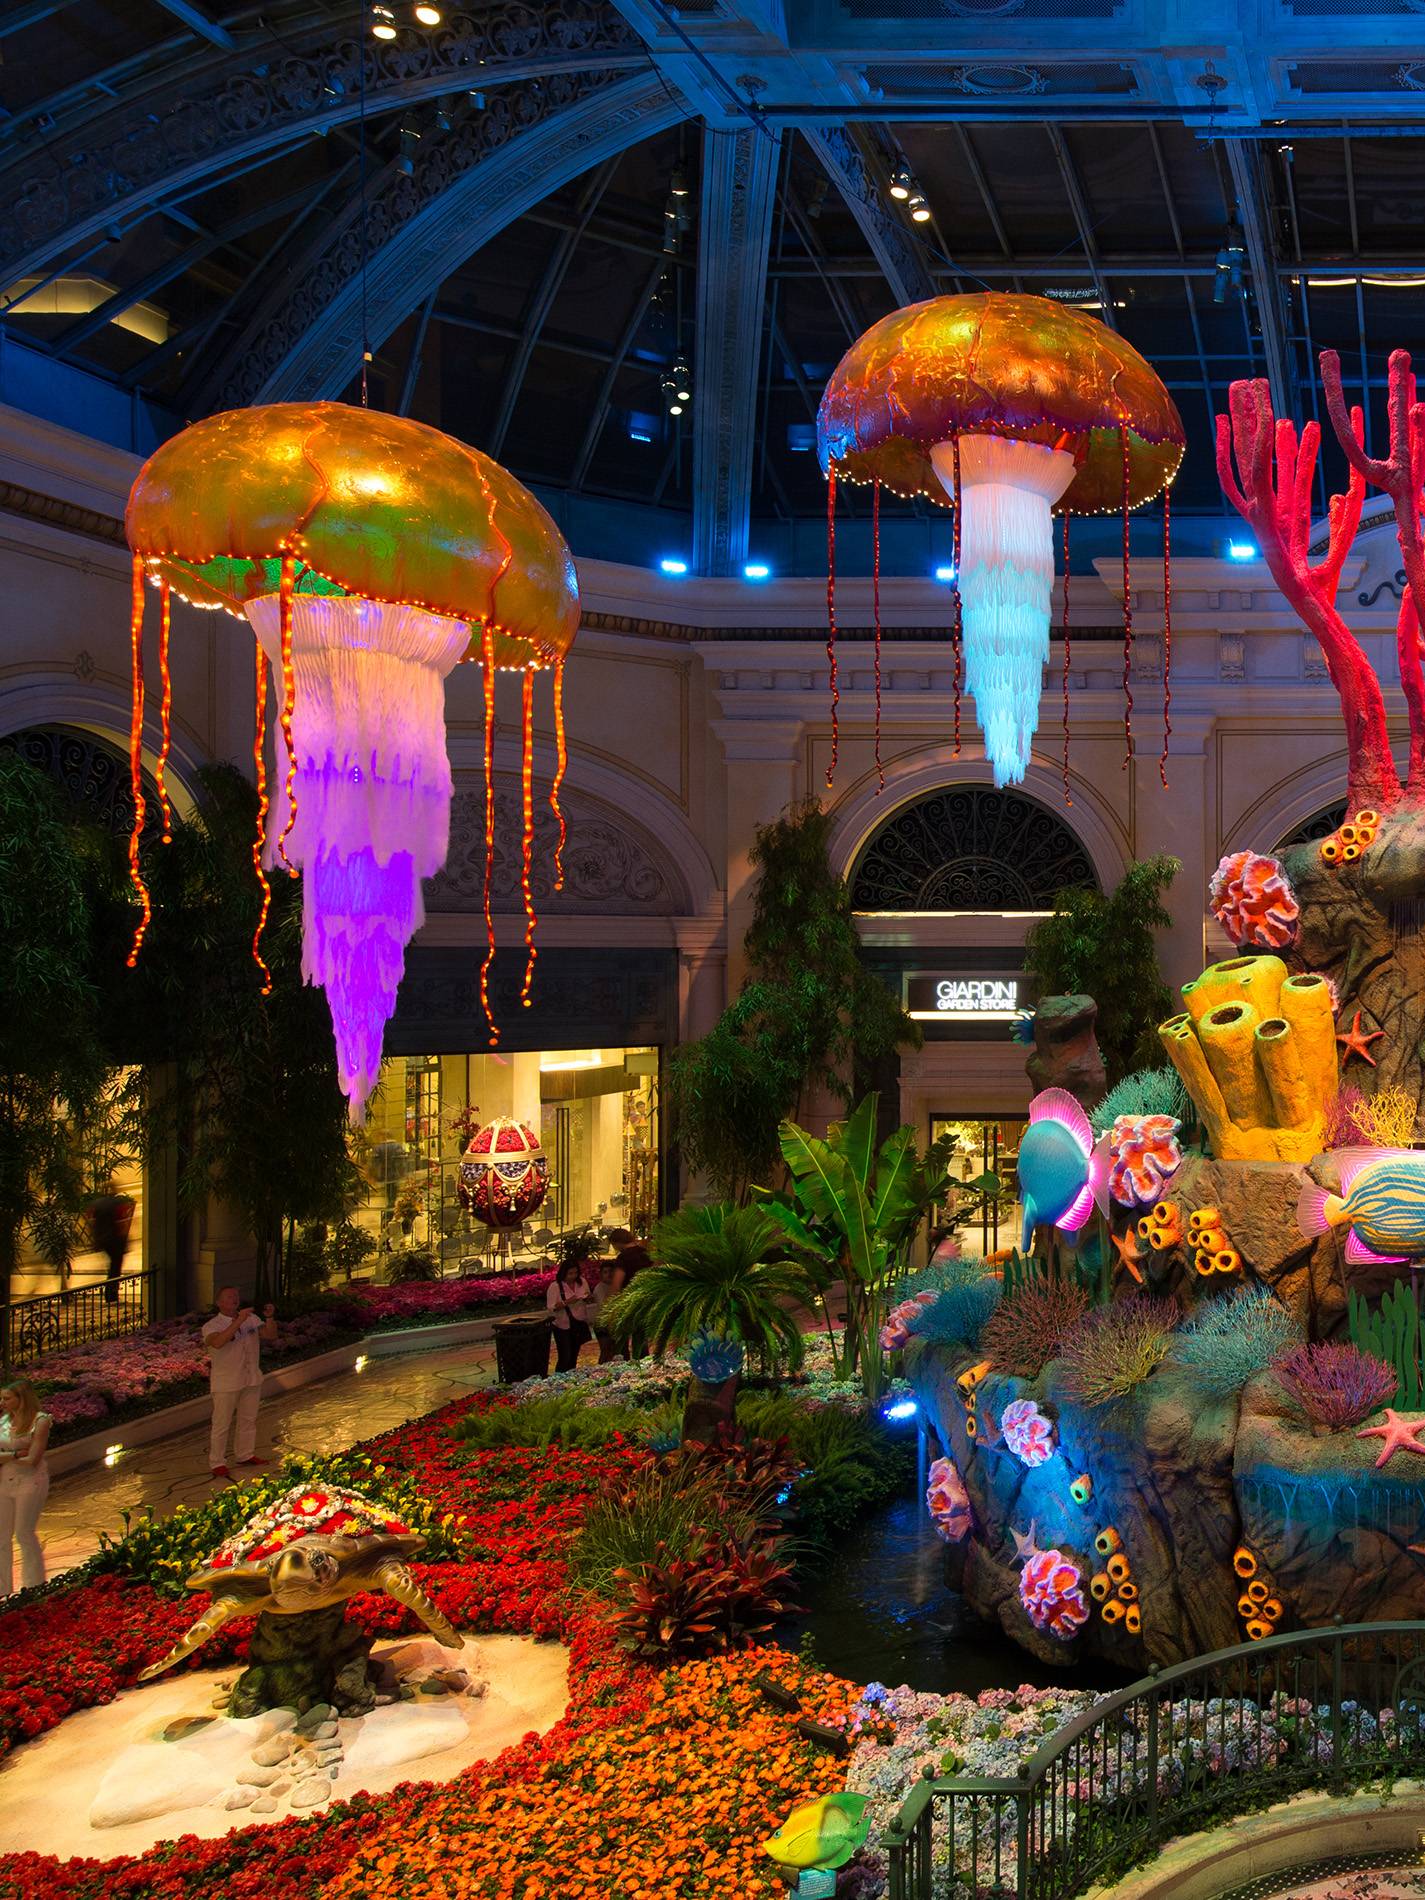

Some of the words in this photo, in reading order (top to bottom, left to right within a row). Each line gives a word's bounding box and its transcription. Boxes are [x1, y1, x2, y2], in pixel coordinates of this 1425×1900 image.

[936, 980, 1017, 999] GIARDINI
[936, 999, 979, 1010] GARDEN
[980, 999, 1017, 1010] STORE
